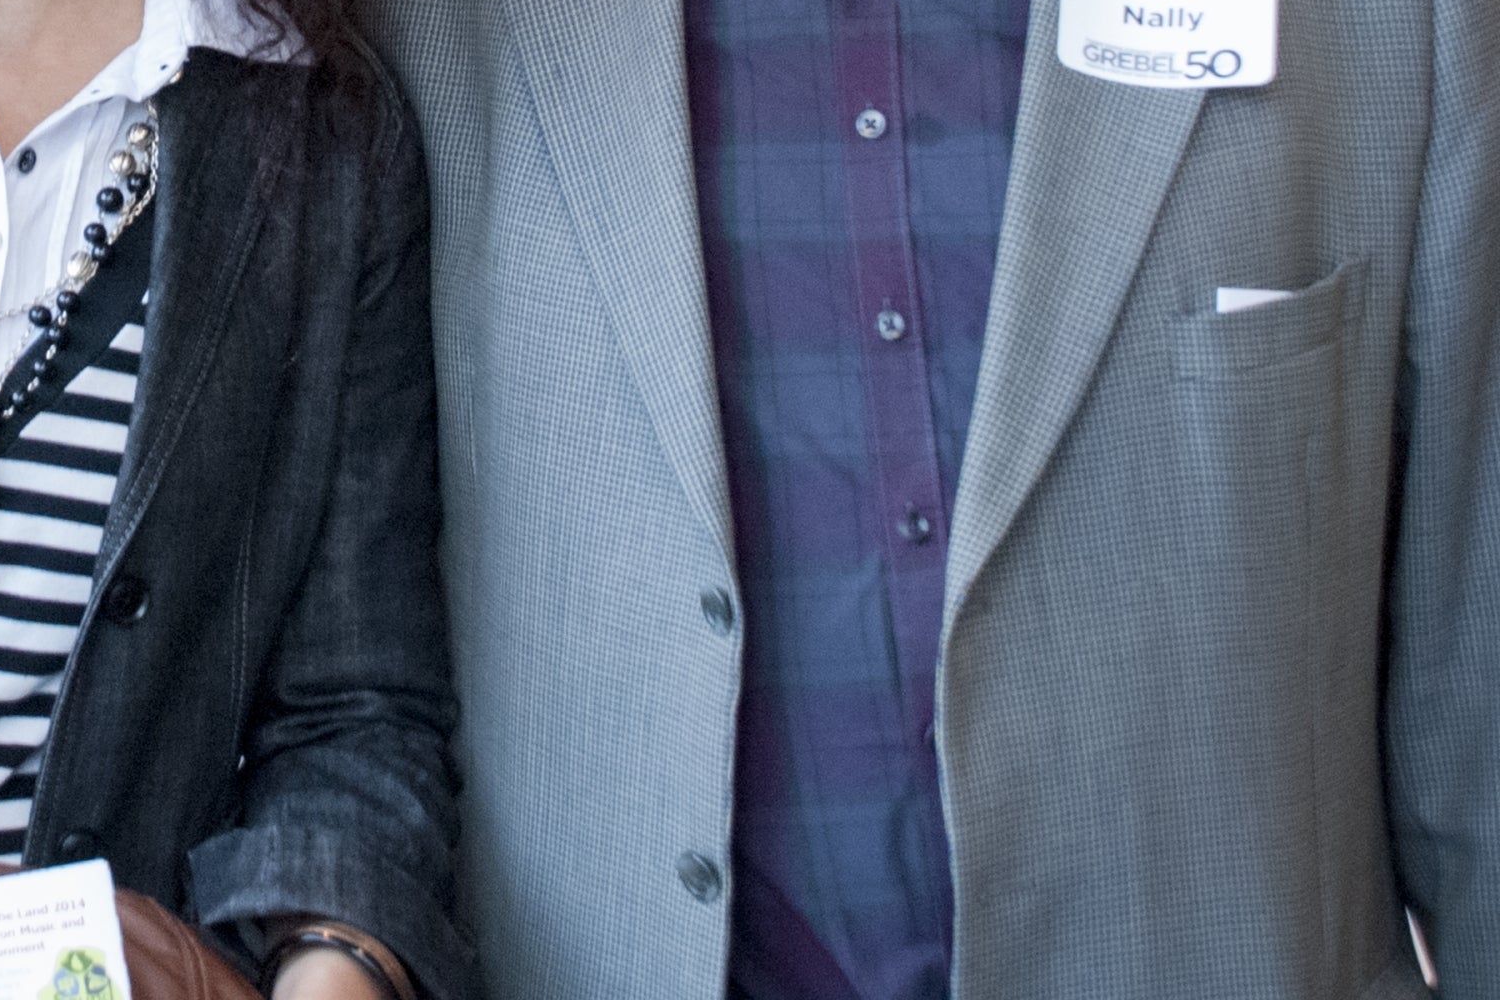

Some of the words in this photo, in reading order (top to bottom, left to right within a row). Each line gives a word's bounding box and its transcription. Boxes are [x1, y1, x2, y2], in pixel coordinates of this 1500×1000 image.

[1122, 5, 1204, 32] Nally
[17, 904, 49, 919] Land
[54, 898, 87, 913] 2014
[0, 928, 16, 939] on
[19, 922, 56, 936] Music
[61, 915, 86, 929] and
